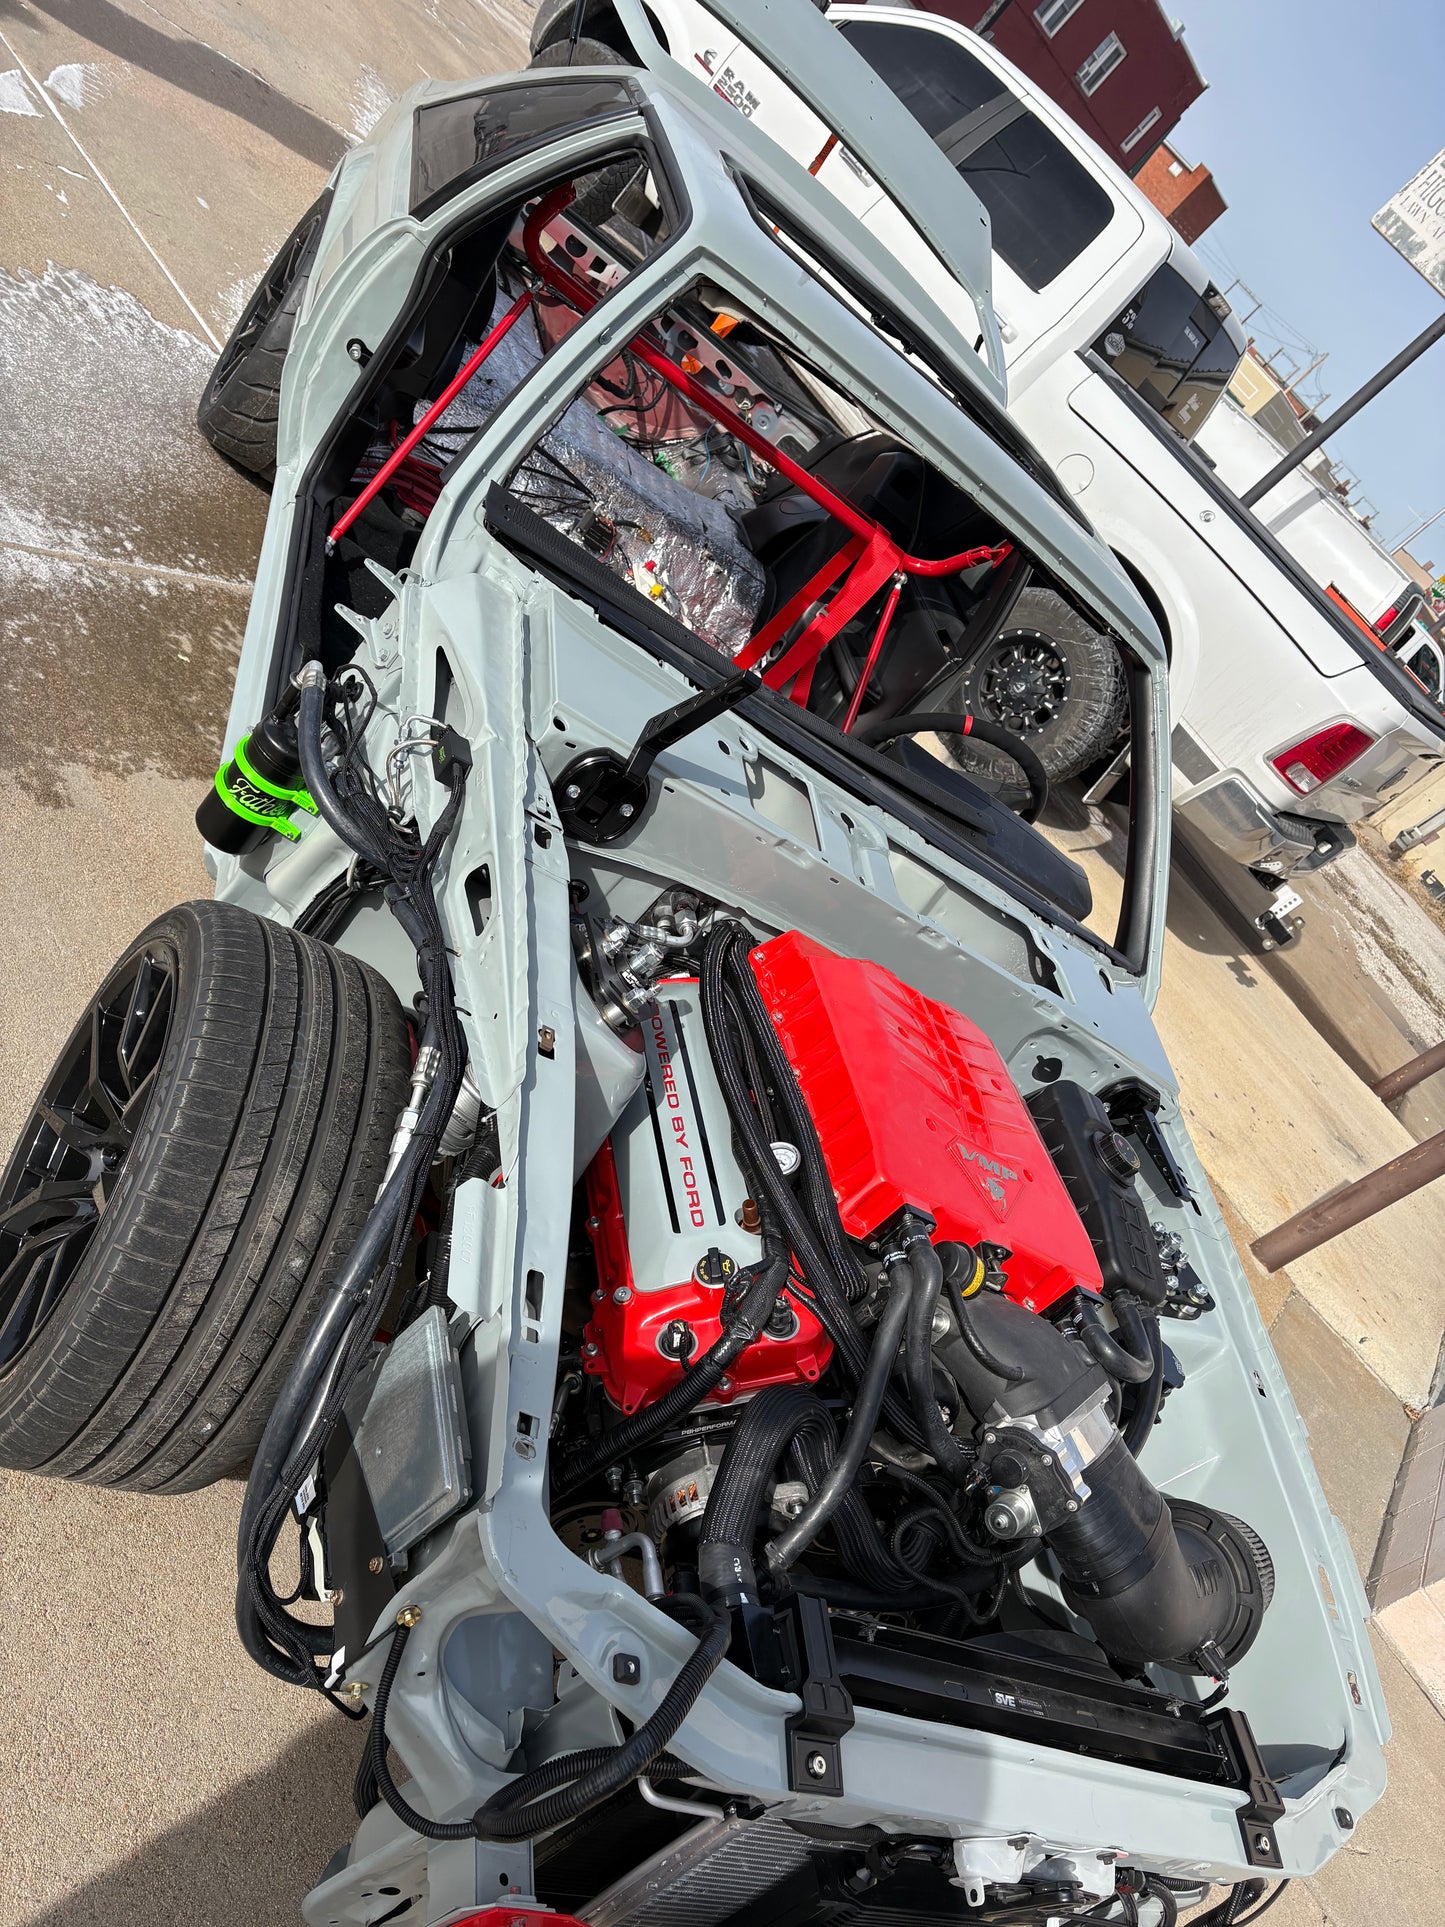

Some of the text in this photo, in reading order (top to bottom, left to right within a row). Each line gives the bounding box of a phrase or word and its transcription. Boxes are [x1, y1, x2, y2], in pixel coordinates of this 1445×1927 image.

[716, 75, 754, 118] 2500
[723, 66, 761, 110] RAM
[671, 1116, 689, 1149] BY
[680, 1156, 705, 1228] FORD
[957, 1143, 1018, 1181] VMP
[994, 1692, 1016, 1708] SVE
